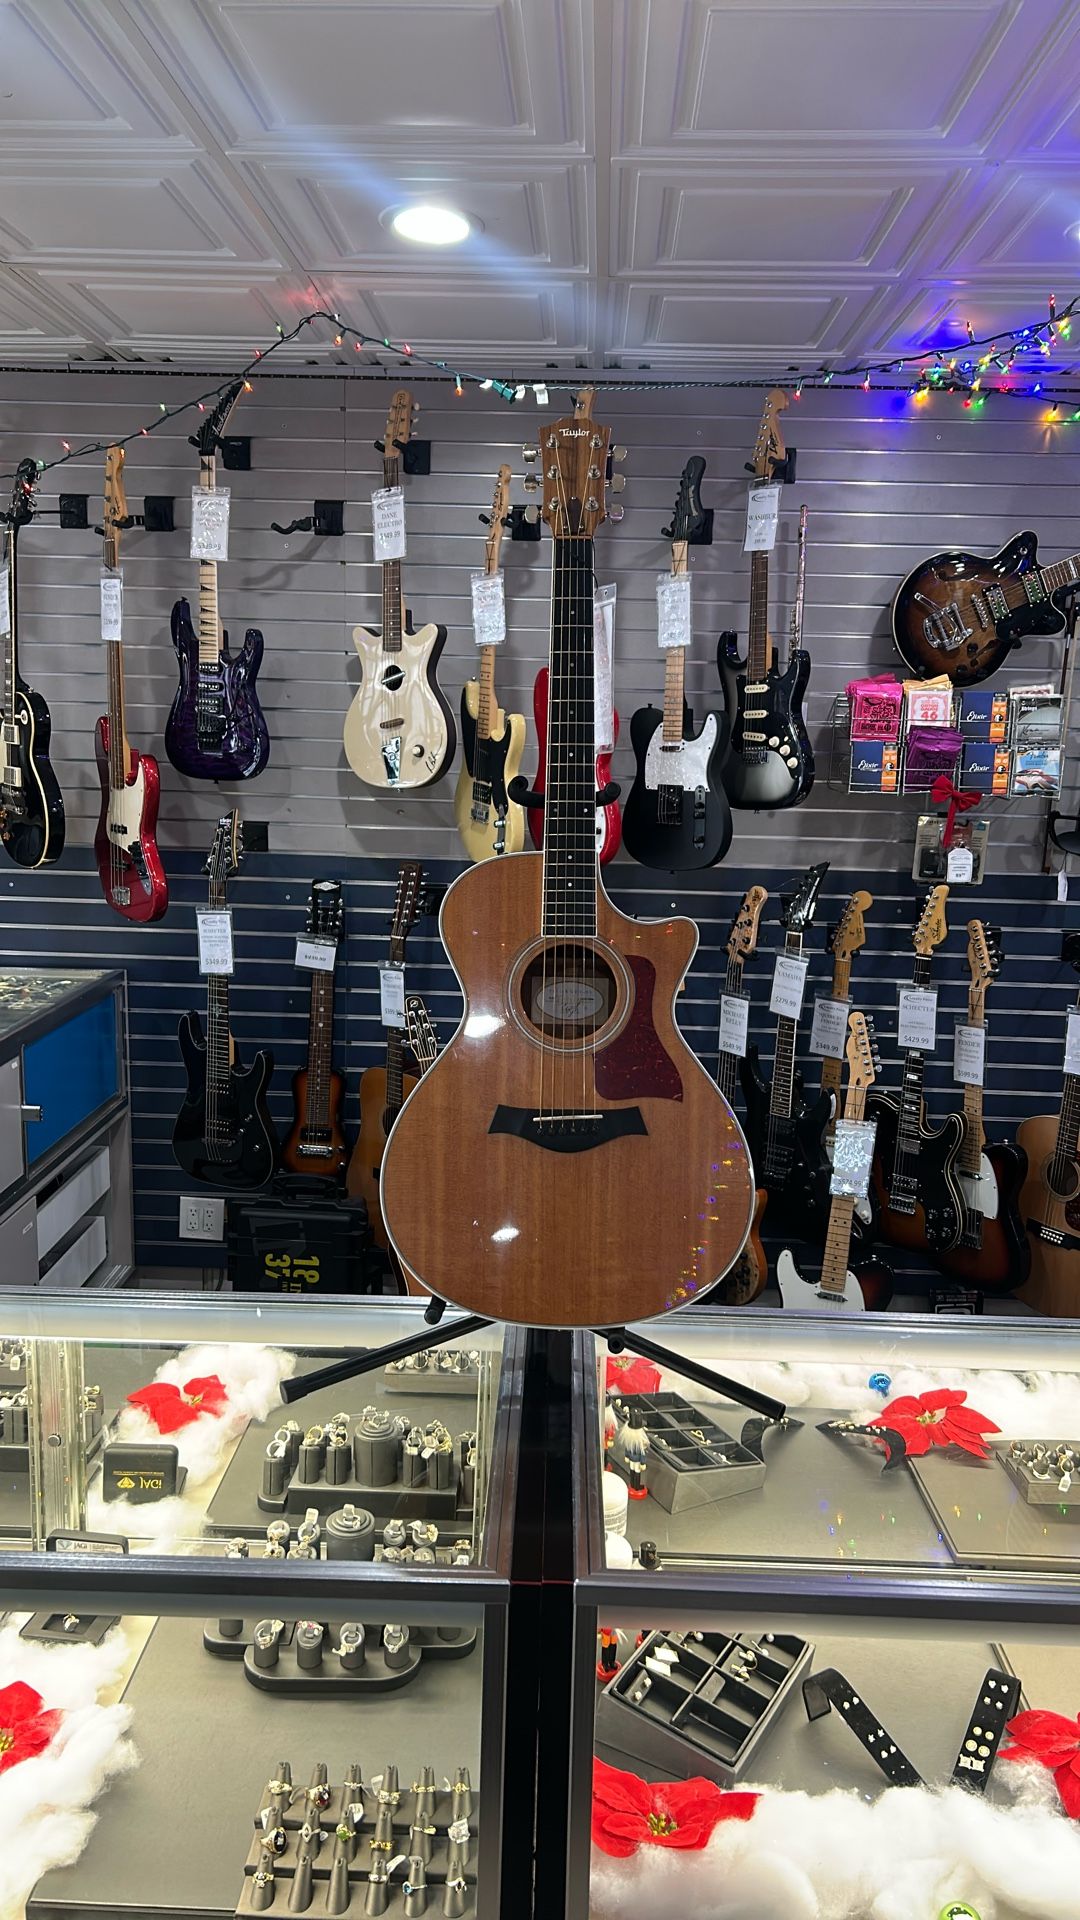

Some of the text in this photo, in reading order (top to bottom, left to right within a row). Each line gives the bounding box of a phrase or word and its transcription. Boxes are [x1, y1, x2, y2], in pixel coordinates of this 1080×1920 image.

[559, 428, 590, 438] Taylor
[921, 711, 938, 720] 46
[967, 710, 988, 721] Elixir
[858, 760, 879, 770] Elixir
[969, 762, 990, 773] Elixir
[903, 1035, 929, 1045] $429.99
[293, 1255, 320, 1284] 18
